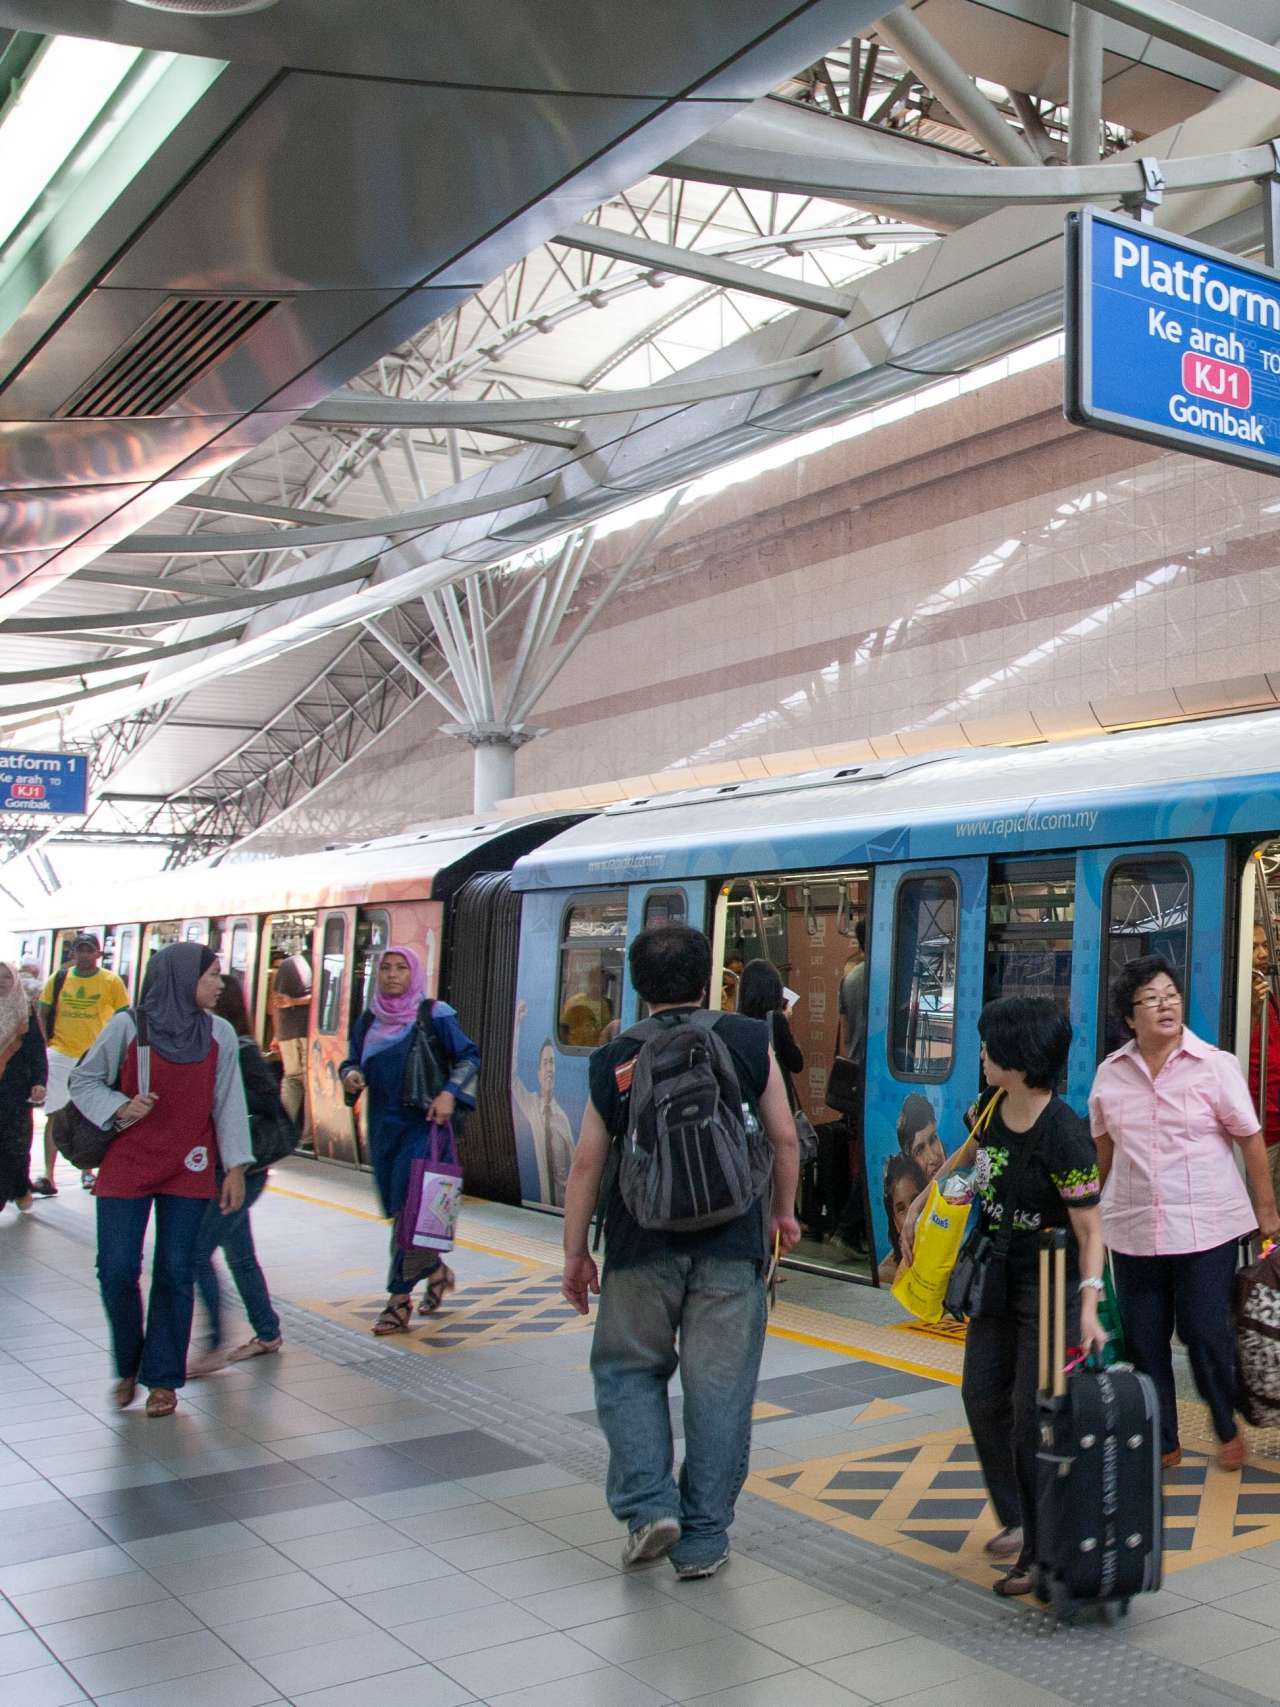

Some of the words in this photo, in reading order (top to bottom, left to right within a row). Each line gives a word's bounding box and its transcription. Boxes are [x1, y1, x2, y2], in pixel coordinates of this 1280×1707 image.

[1113, 236, 1280, 331] Platform
[1148, 307, 1182, 344] Ke
[1189, 327, 1245, 363] arah
[1194, 361, 1239, 400] KJ1
[1168, 394, 1265, 445] Gombak
[0, 755, 61, 771] atform
[67, 758, 76, 772] 1
[15, 774, 43, 785] arah
[17, 786, 40, 796] KJ1
[4, 798, 51, 810] Gombak
[955, 810, 1099, 840] www.rapidkl.com.my
